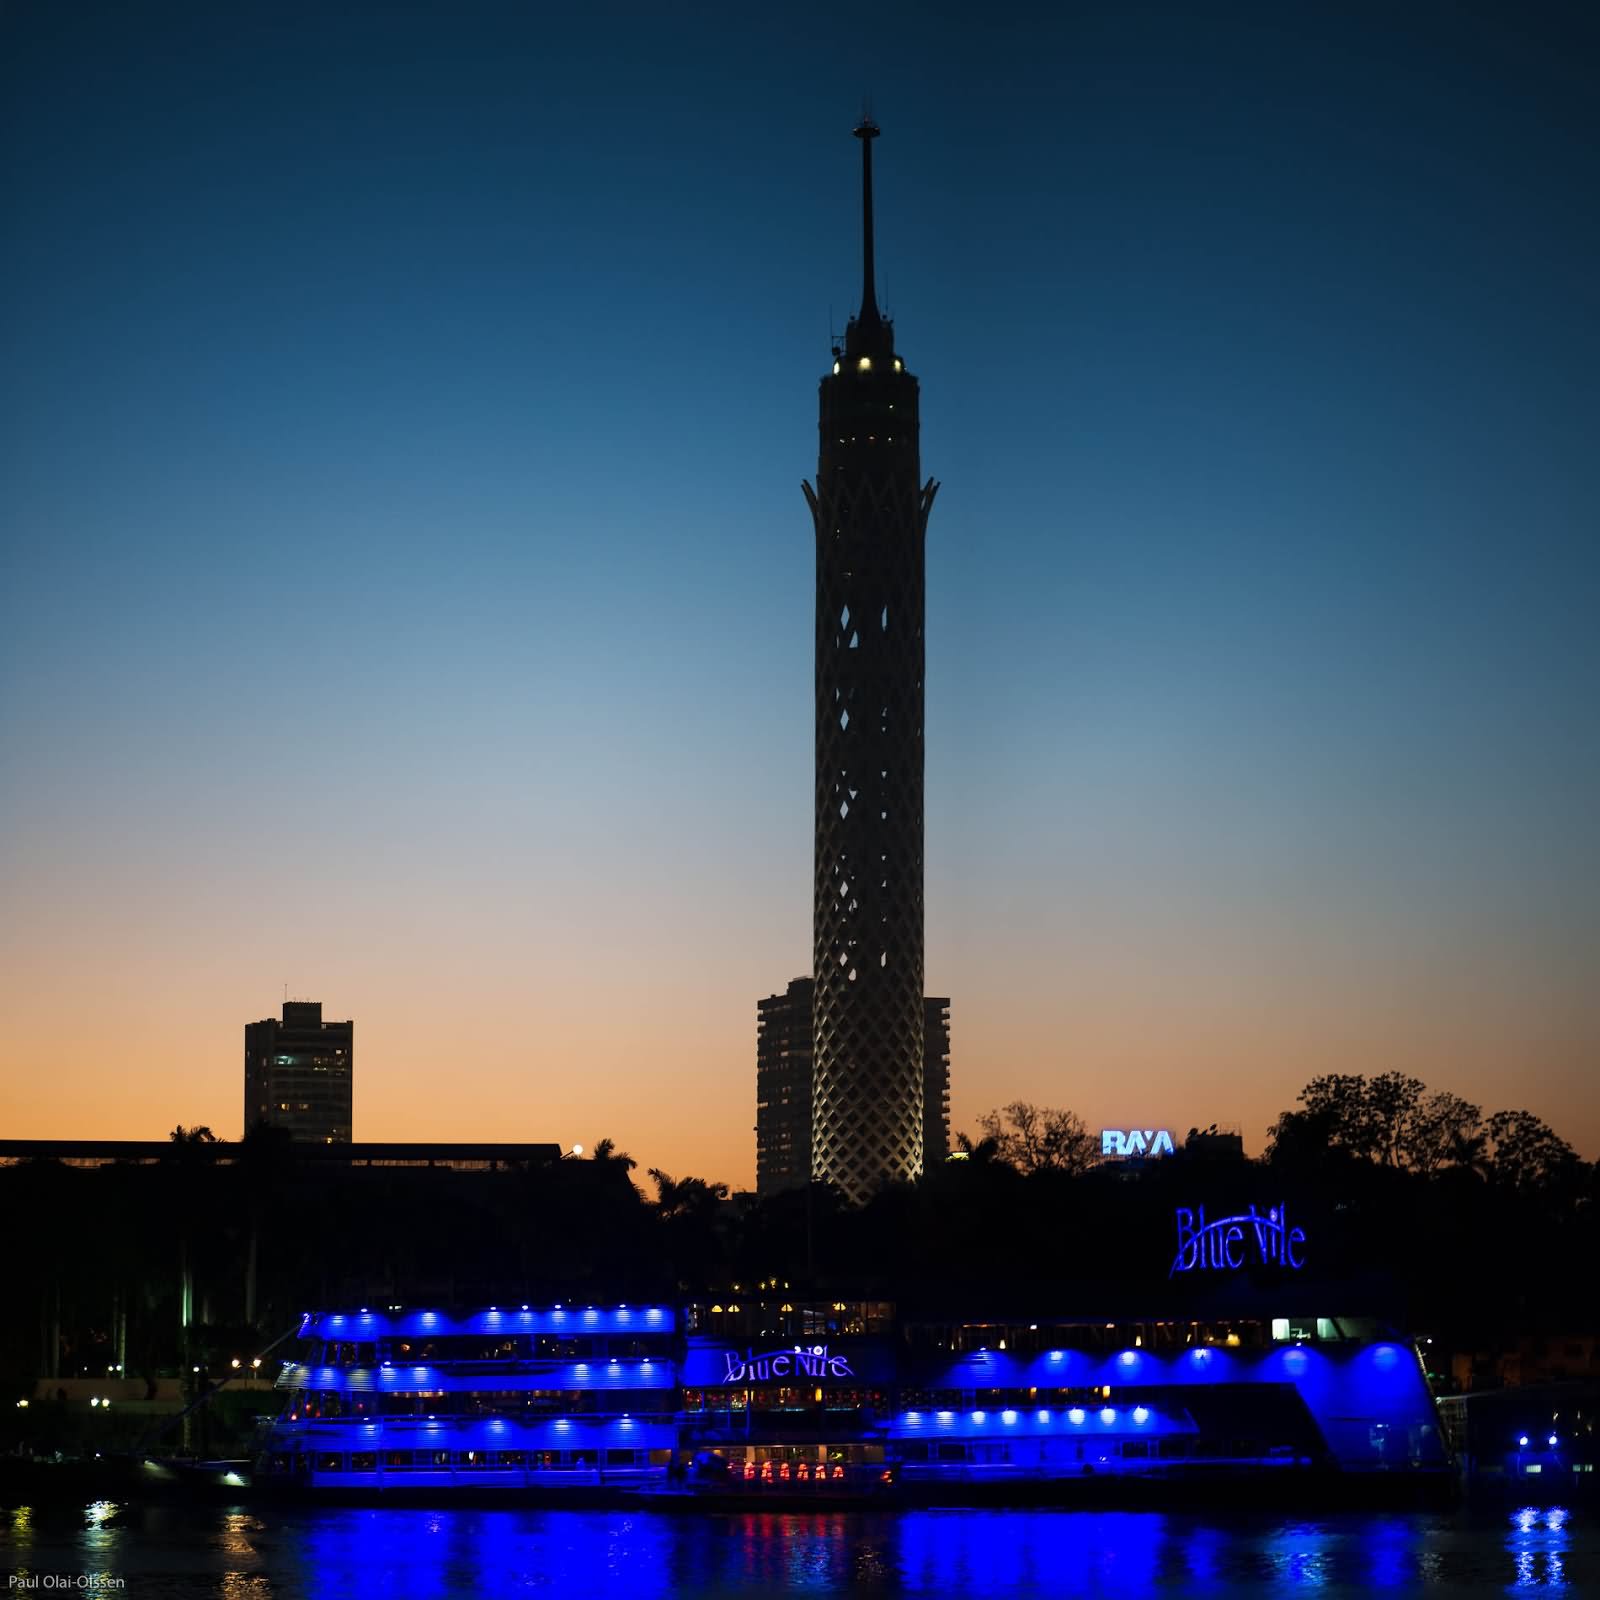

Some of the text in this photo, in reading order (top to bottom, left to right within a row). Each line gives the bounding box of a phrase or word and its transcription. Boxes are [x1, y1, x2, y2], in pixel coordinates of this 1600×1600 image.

[1102, 1130, 1174, 1155] RAYA
[1171, 1202, 1245, 1275] Blue
[723, 1345, 851, 1383] Blue Nile
